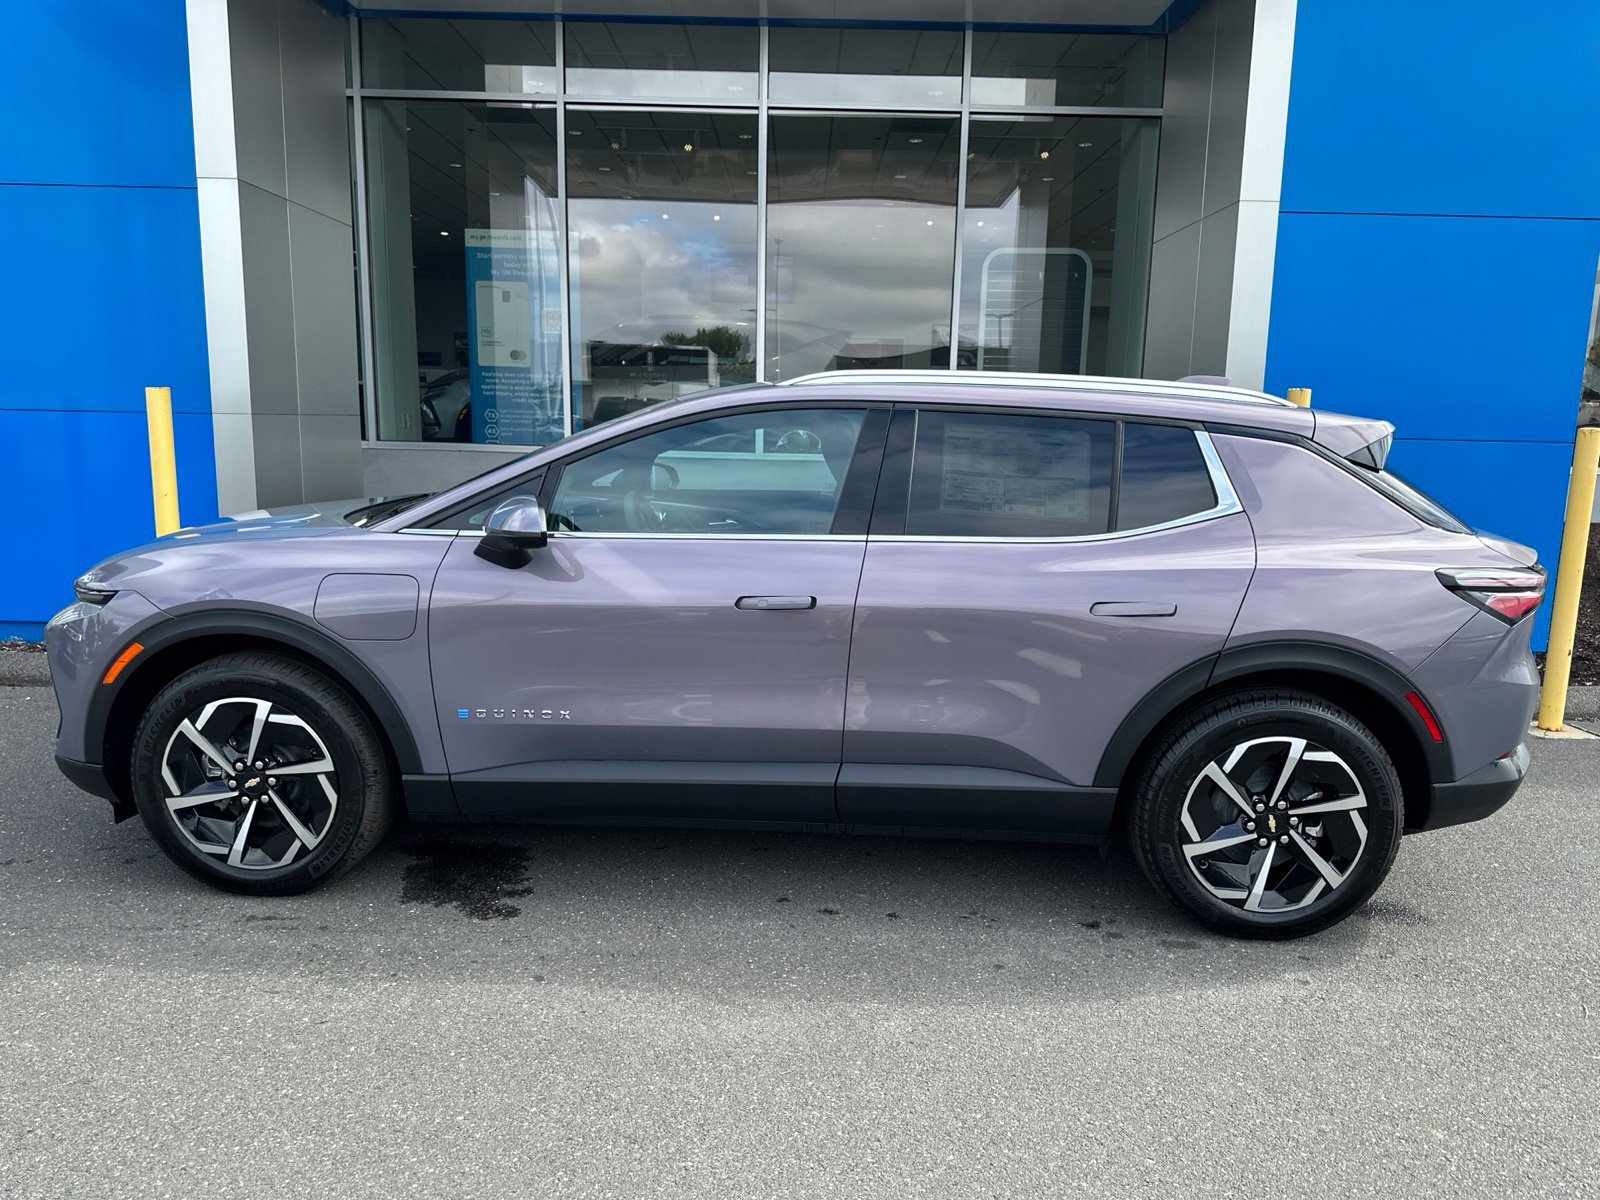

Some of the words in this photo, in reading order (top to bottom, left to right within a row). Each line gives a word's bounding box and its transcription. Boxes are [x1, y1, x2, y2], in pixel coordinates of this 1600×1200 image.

[143, 695, 183, 753] MICHELIN
[1353, 745, 1391, 807] MICHELIN
[311, 817, 353, 874] MICHELIN
